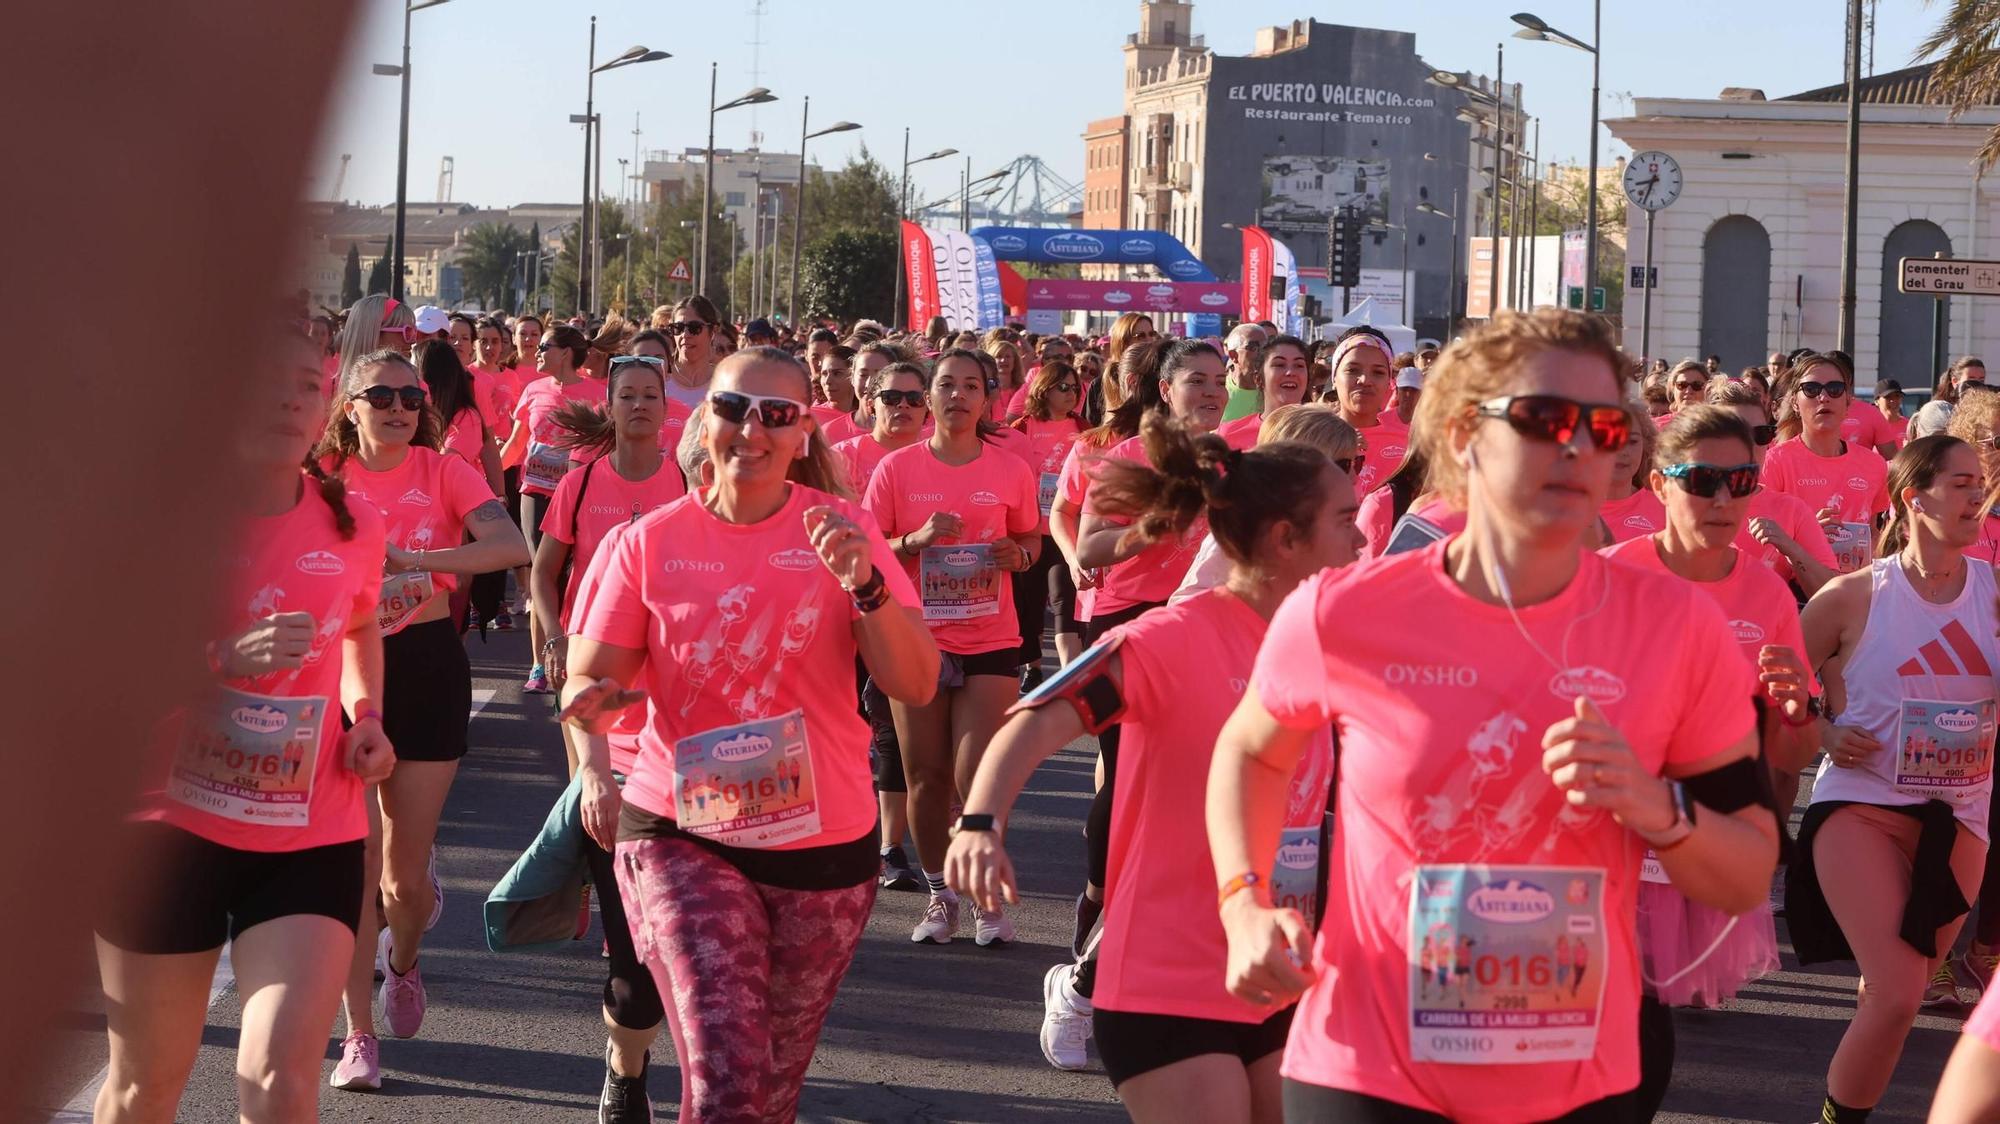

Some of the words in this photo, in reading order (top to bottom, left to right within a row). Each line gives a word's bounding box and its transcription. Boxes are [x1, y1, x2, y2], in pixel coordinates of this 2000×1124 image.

[1228, 86, 1248, 100] EL
[1251, 83, 1316, 101] PUERTO
[1322, 84, 1434, 108] VALENCIA.com
[1244, 108, 1340, 122] Restaurante
[1345, 111, 1412, 125] Tematico
[1048, 241, 1099, 253] ASTURIANA
[1907, 264, 1969, 275] cementeri
[1906, 278, 1926, 288] del
[1934, 279, 1964, 290] Grau
[909, 493, 943, 502] OYSHO
[590, 506, 624, 515] OYSHO
[664, 560, 724, 573] OYSHO
[948, 578, 978, 590] 016
[1384, 663, 1478, 687] OYSHO
[225, 749, 279, 775] 016
[1936, 748, 1976, 764] 016
[722, 777, 776, 804] 016
[1474, 955, 1552, 987] 016
[1470, 1013, 1486, 1026] DE
[1488, 1013, 1503, 1026] LA
[1431, 1035, 1494, 1052] OYSHO
